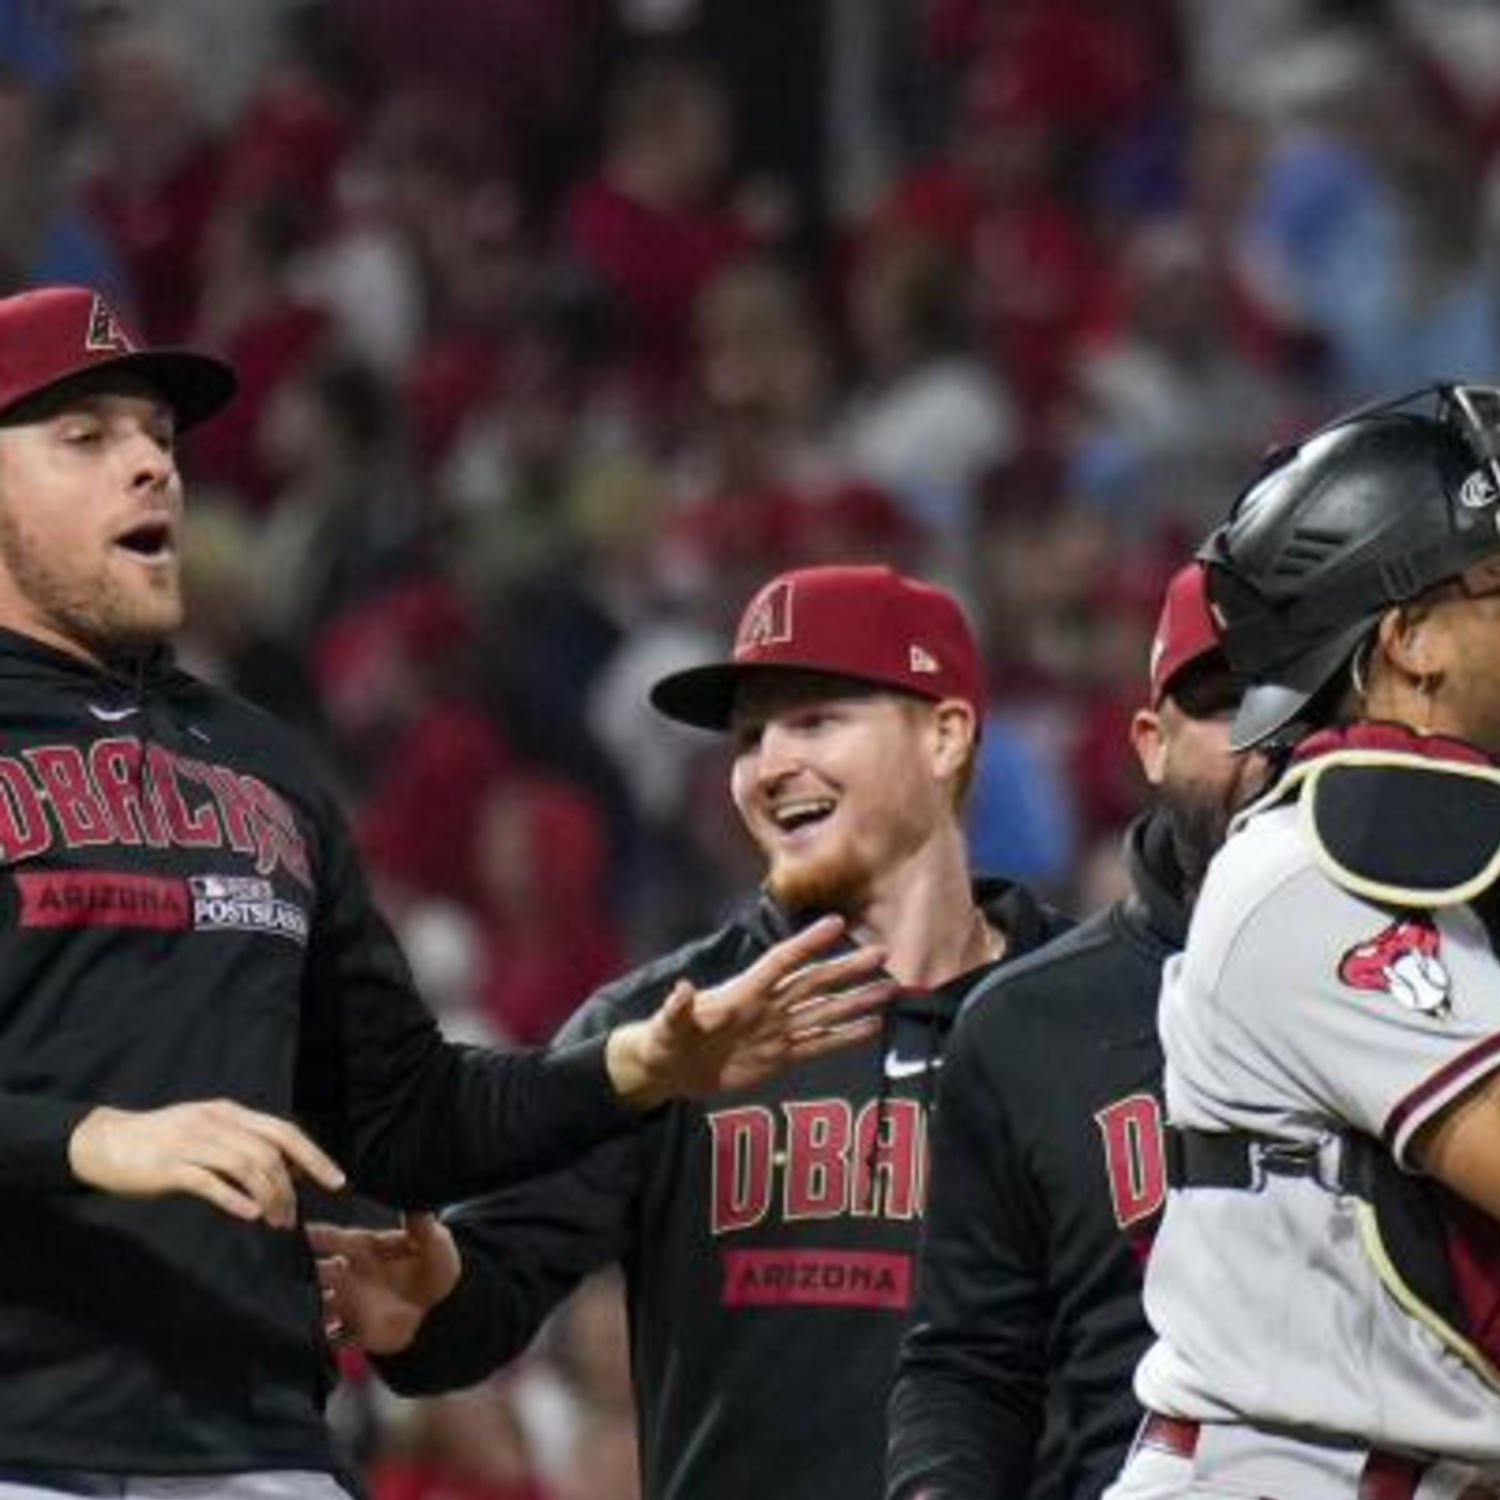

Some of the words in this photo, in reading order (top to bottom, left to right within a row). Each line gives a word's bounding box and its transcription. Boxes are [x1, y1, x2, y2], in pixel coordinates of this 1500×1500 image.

[734, 578, 795, 662] A
[37, 884, 183, 912] ARIZONA
[743, 1261, 897, 1291] ARIZONA
